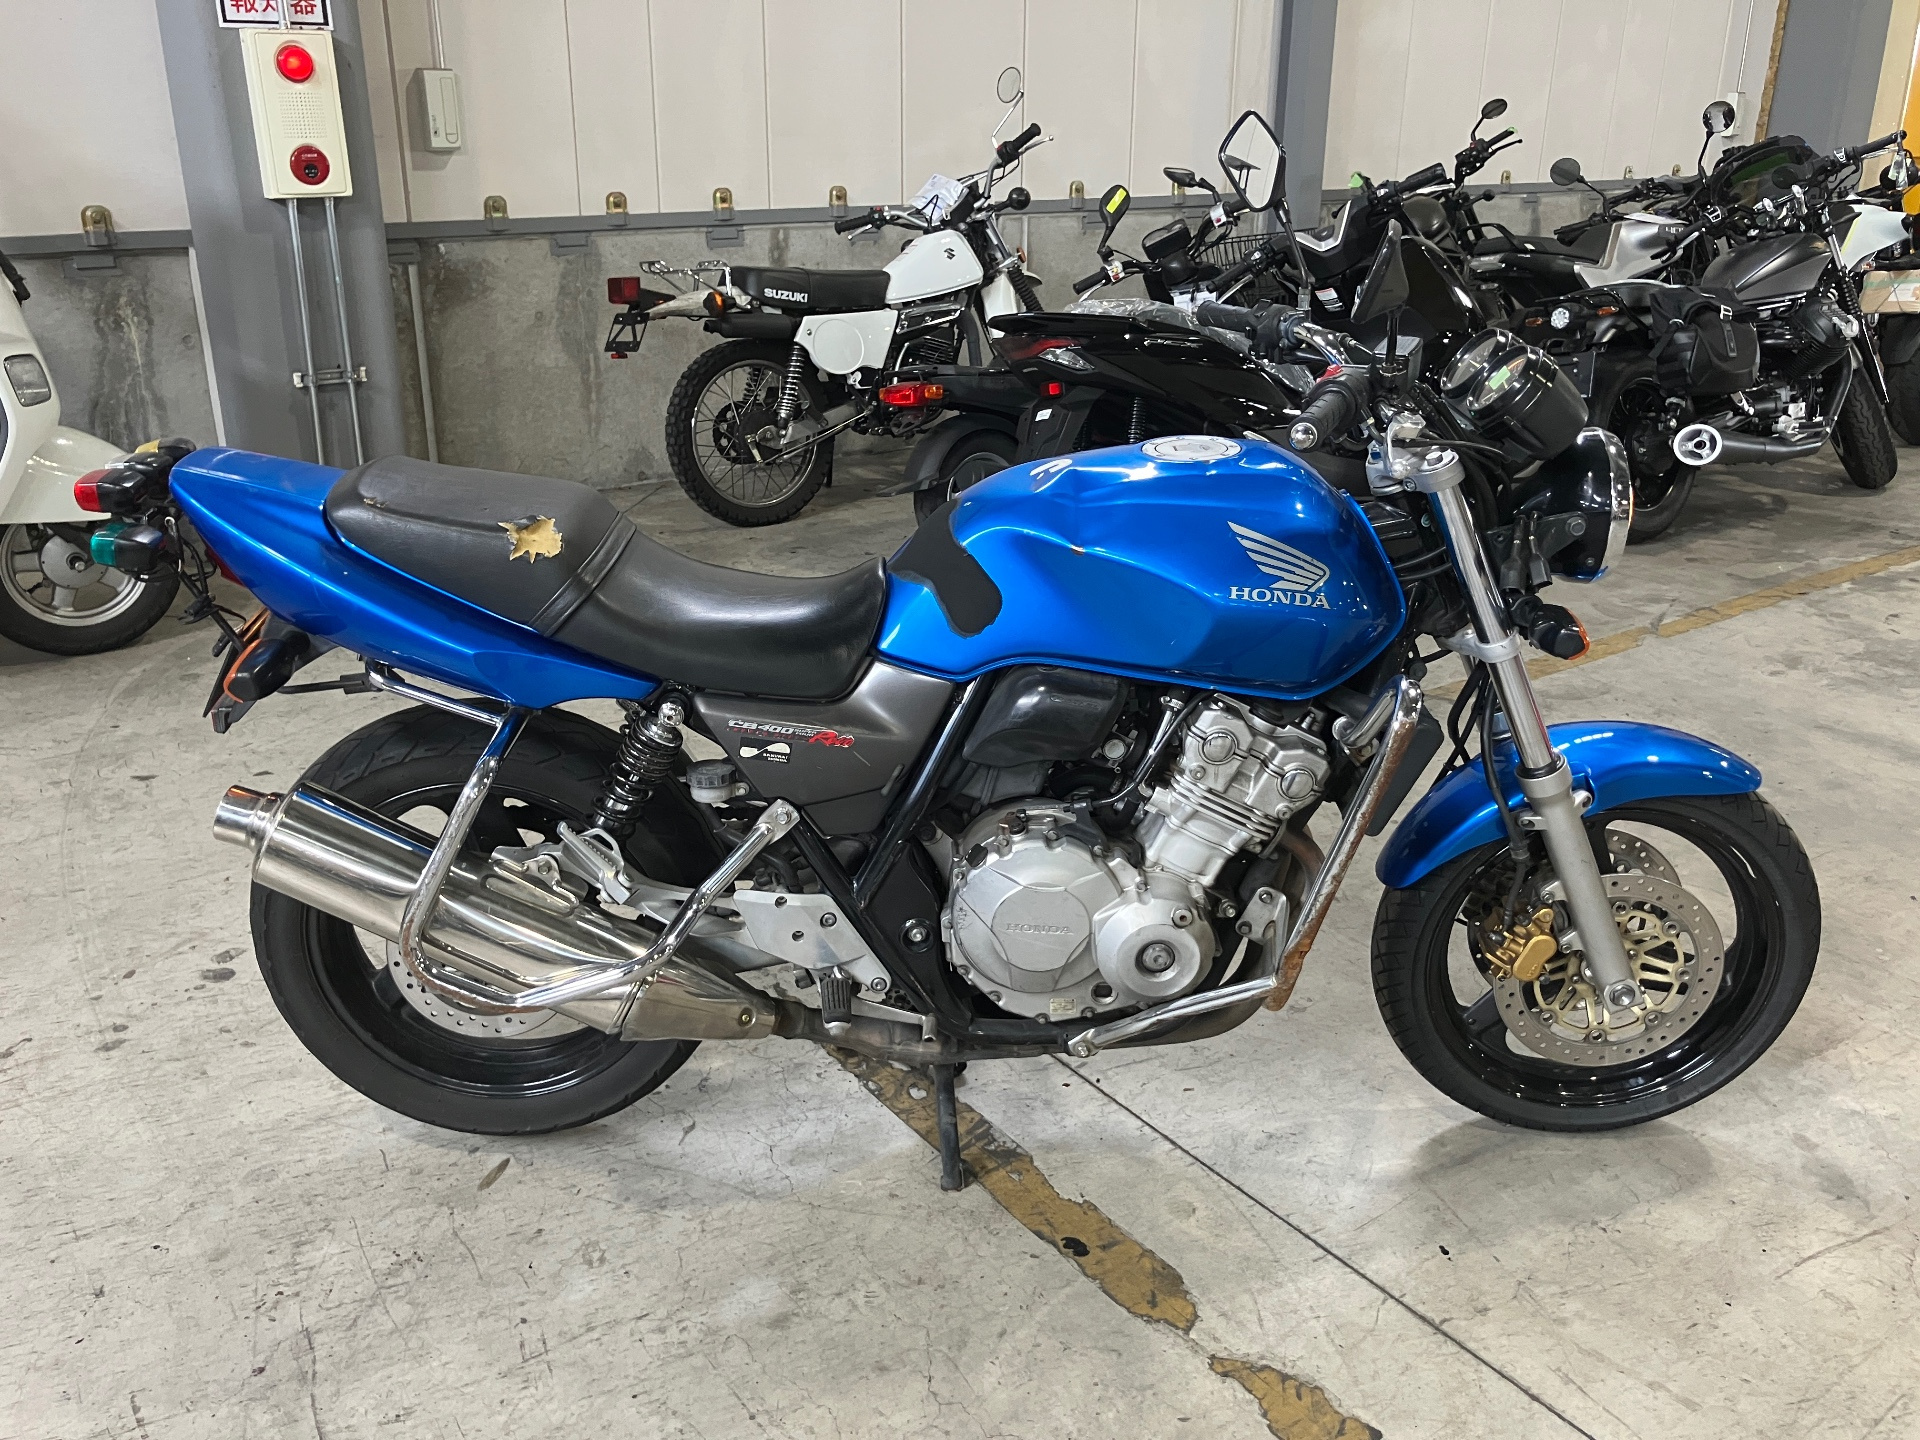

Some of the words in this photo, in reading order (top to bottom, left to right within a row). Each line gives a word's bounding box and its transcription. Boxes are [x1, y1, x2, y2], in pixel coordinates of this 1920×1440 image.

[763, 287, 808, 303] SUZUKI
[1228, 586, 1331, 610] HONDA
[1006, 923, 1074, 936] HONDA
